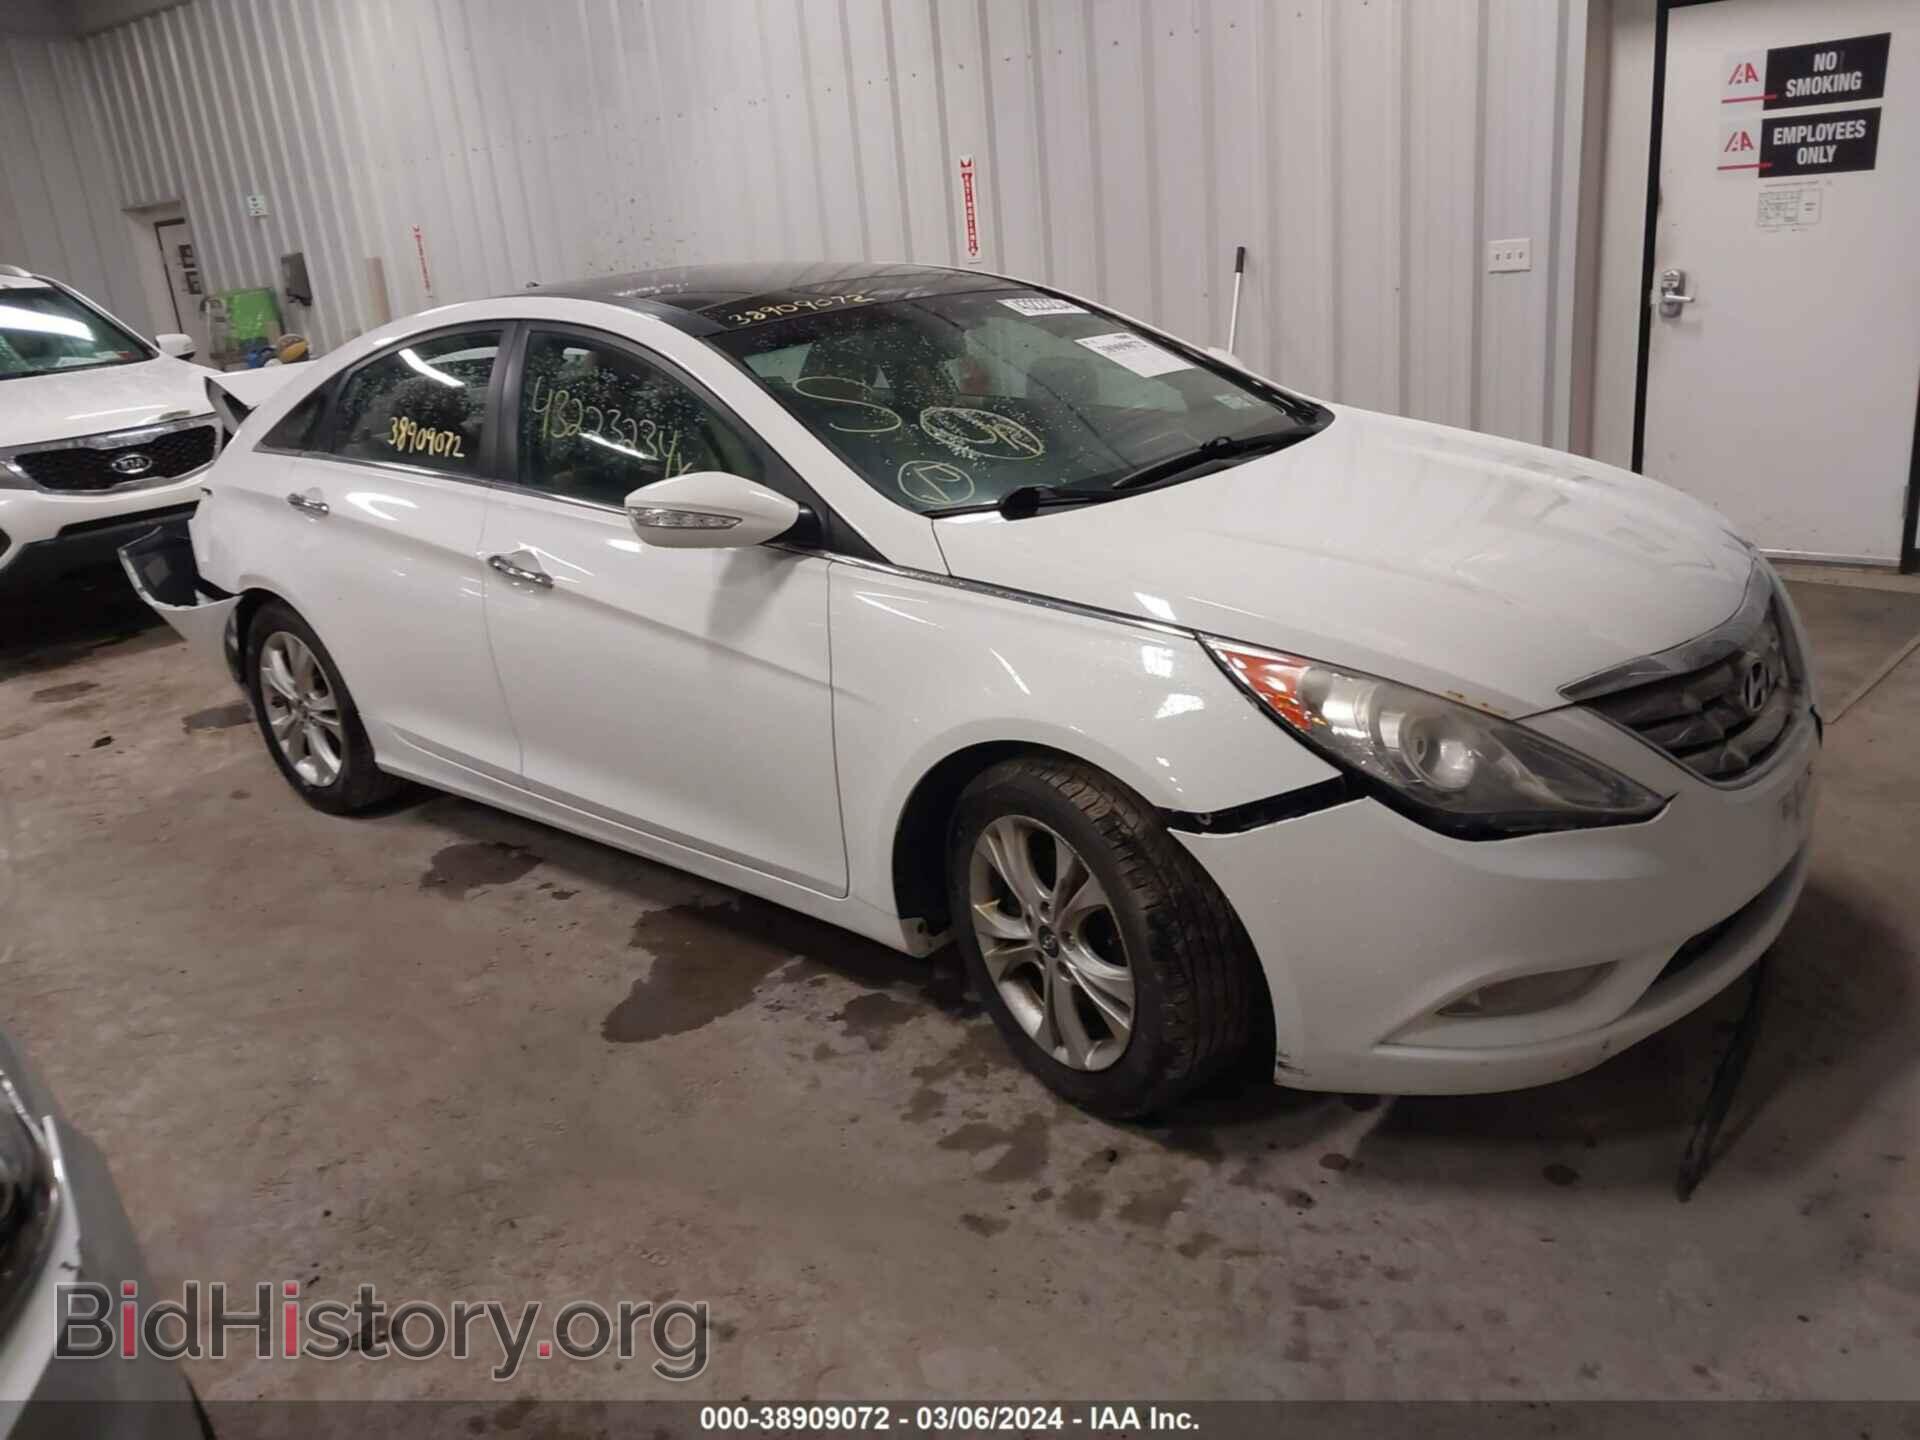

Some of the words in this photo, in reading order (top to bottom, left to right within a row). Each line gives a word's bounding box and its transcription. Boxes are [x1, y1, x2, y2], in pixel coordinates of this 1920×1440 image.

[1813, 51, 1838, 72] NO
[1786, 71, 1863, 98] SMOKING
[1772, 119, 1867, 146] EMPLOYEES
[1796, 145, 1838, 165] ONLY
[387, 415, 466, 458] 38909072
